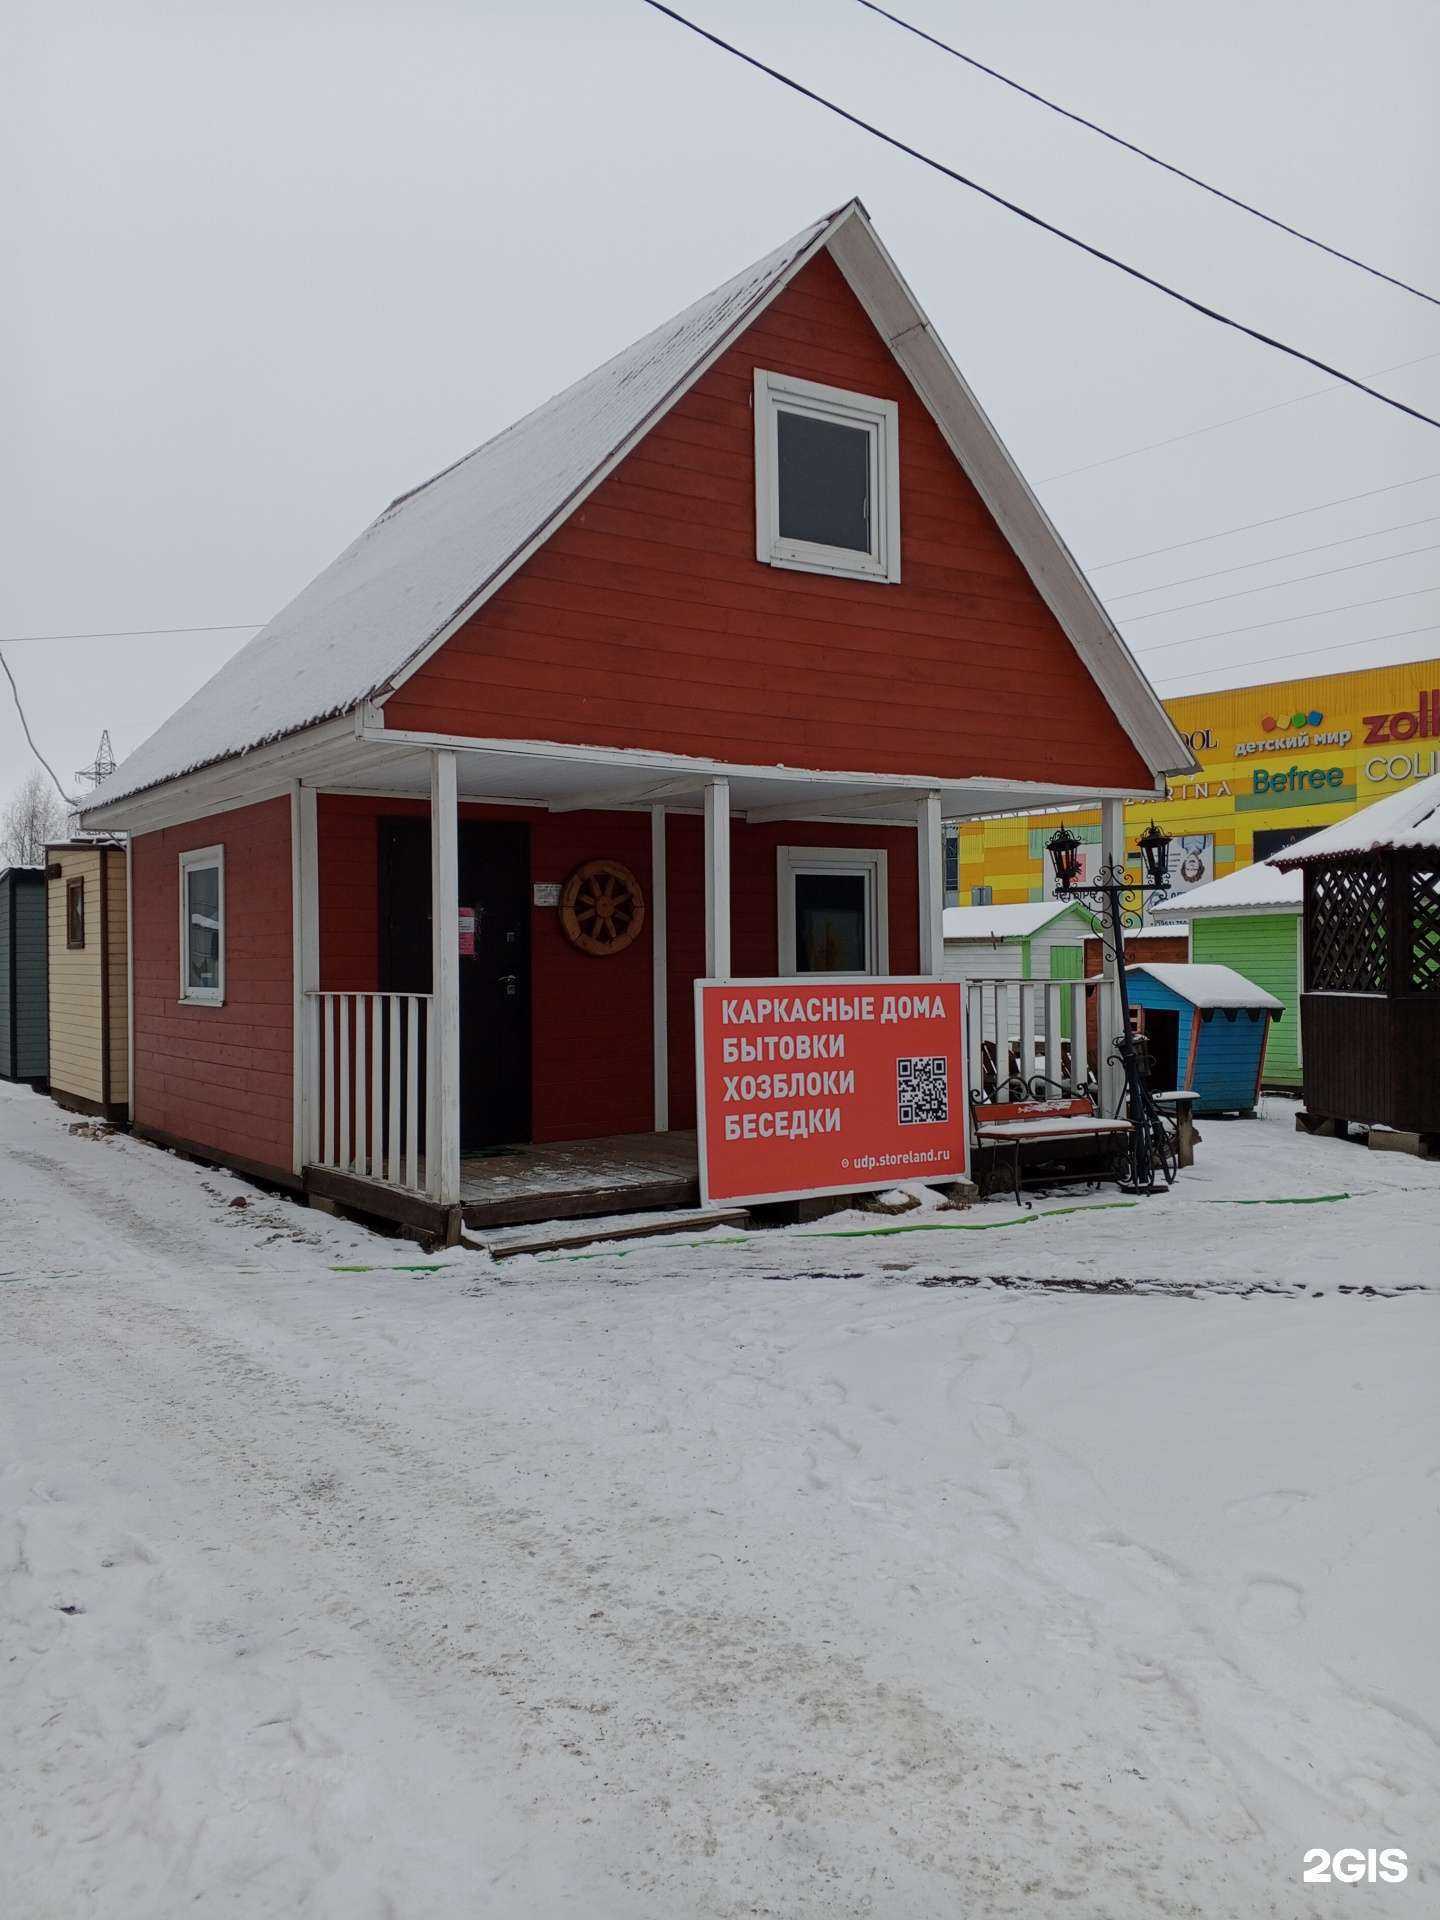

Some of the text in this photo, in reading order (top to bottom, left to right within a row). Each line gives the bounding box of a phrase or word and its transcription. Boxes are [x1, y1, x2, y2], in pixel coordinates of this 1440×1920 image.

[1235, 729, 1352, 756] детский мир
[1253, 765, 1344, 794] Befree
[721, 995, 946, 1024] КАРКАСНЫЕ ДОМА
[722, 1034, 845, 1063] БЫТОВКИ
[723, 1070, 855, 1102] ХОЗБЛОКИ
[724, 1107, 841, 1141] БЕСЕДКИ
[853, 1149, 950, 1170] udp.storeland.ru
